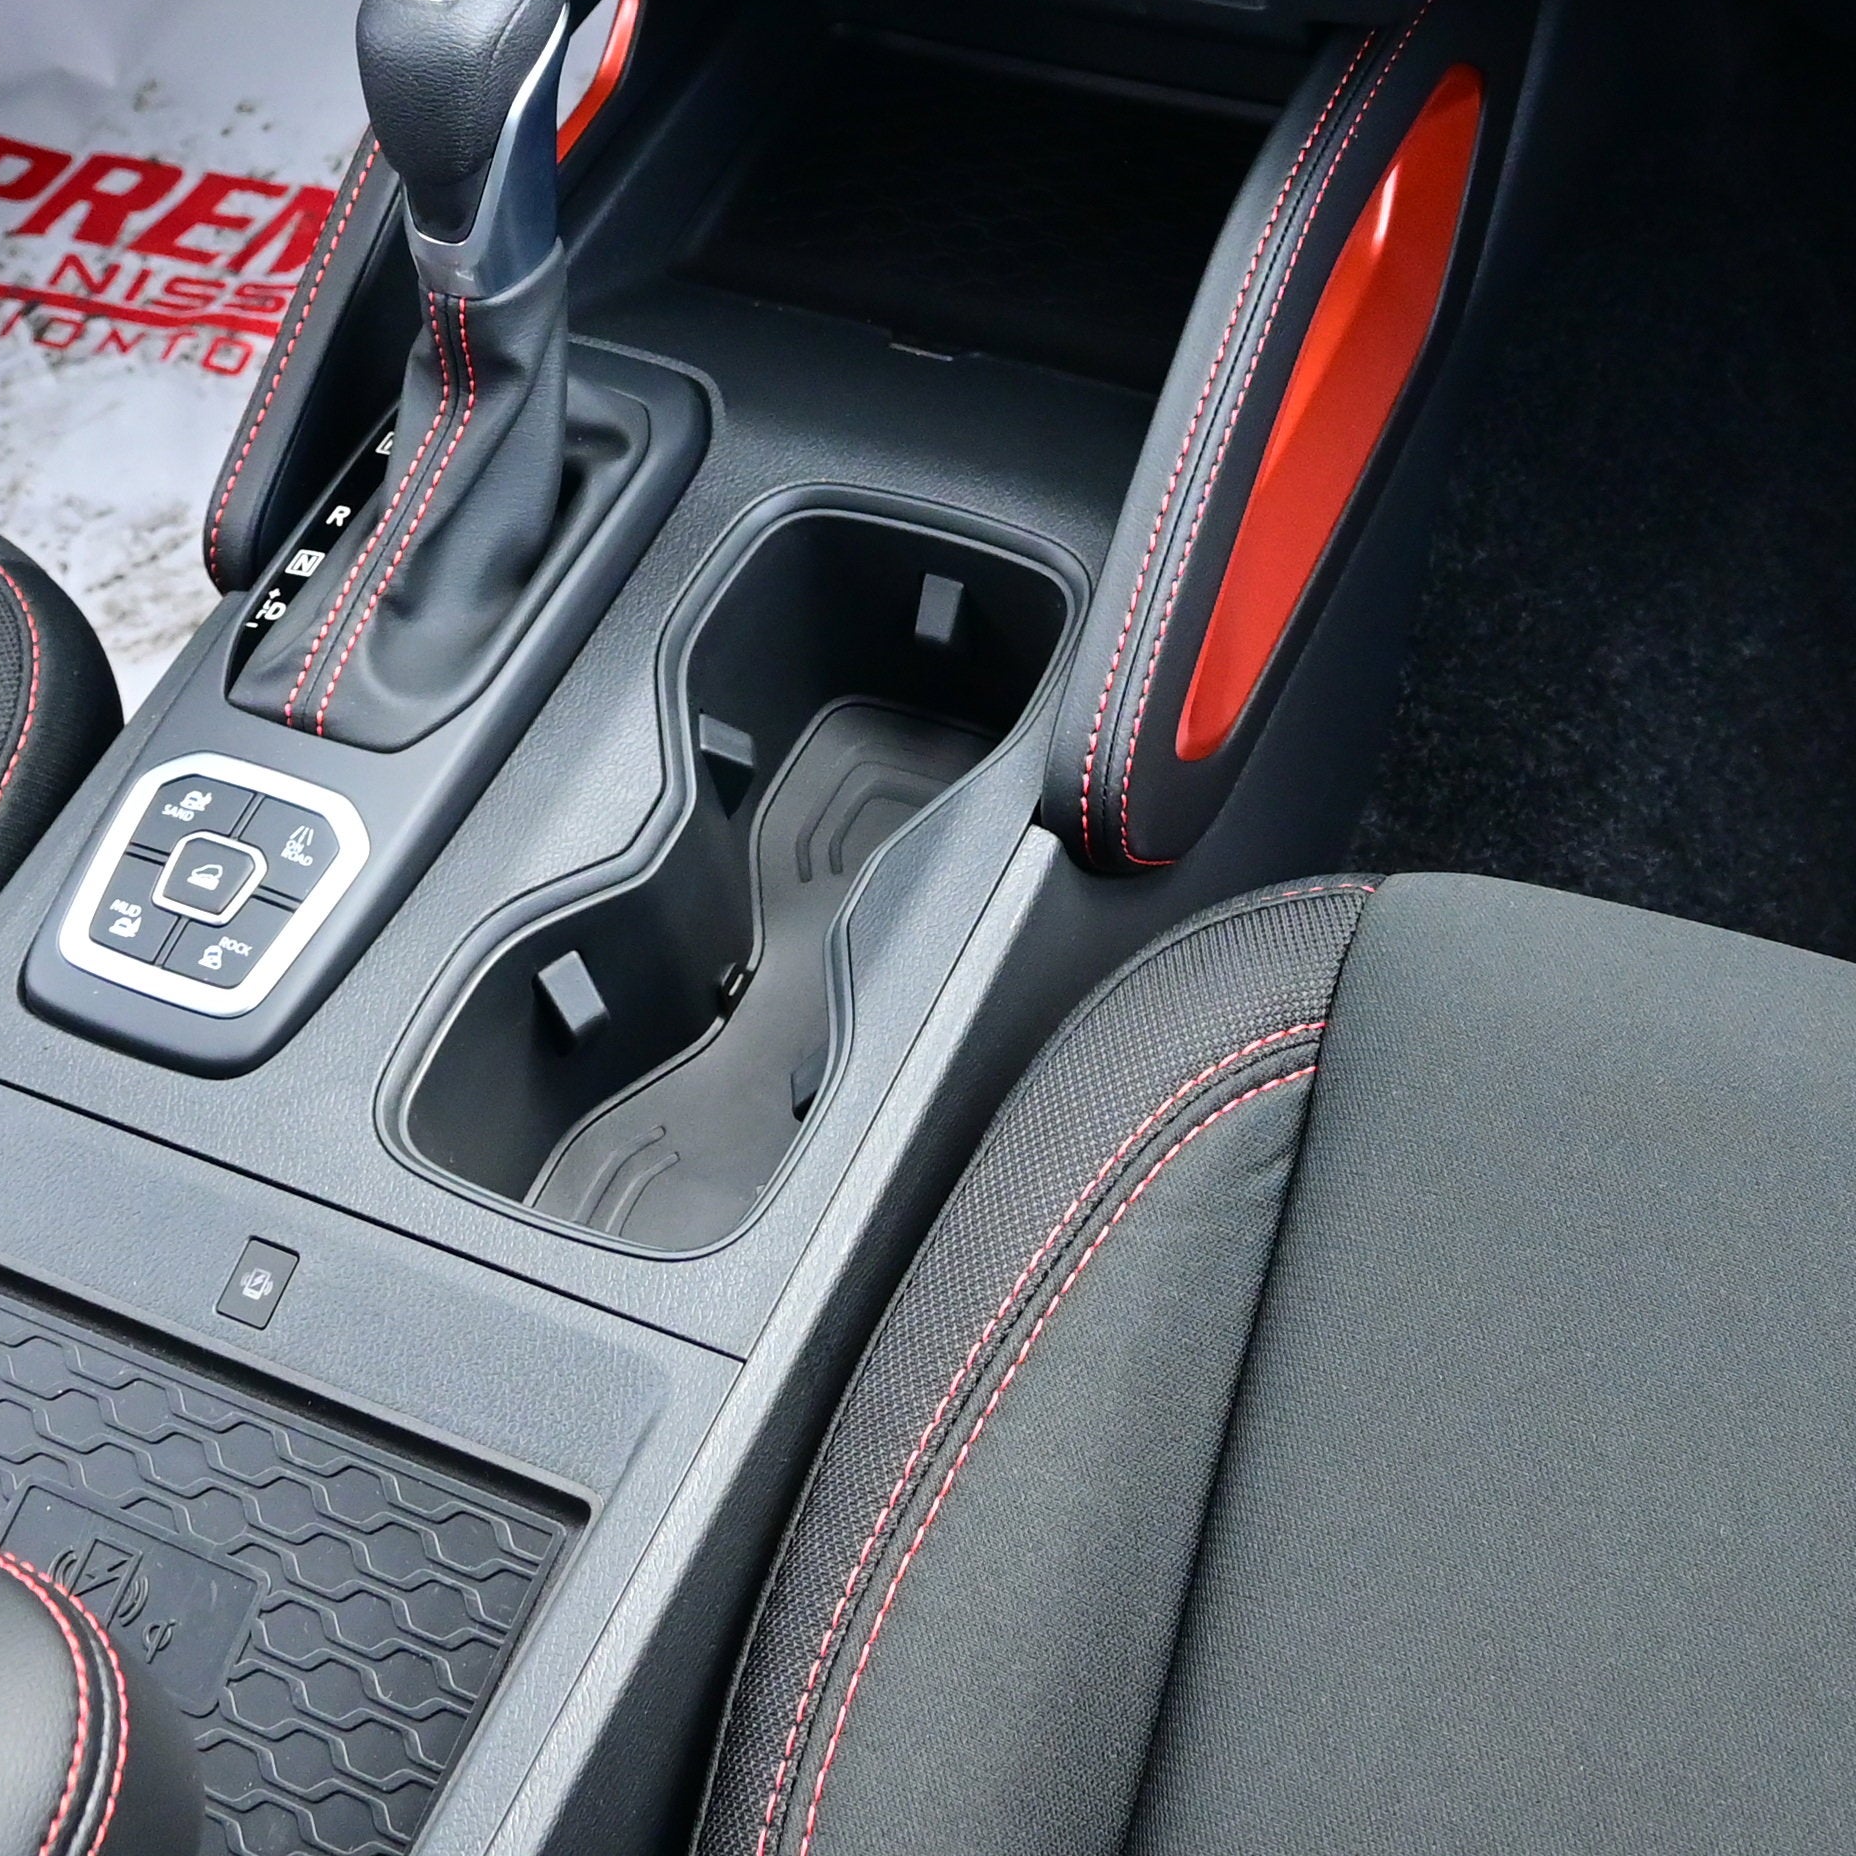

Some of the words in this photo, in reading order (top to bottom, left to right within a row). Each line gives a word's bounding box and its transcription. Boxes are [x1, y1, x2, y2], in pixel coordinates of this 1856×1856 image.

[326, 505, 351, 527] R
[161, 804, 195, 822] SAND
[280, 848, 313, 866] ROAD
[111, 899, 142, 917] MUD
[219, 936, 253, 956] ROCK
